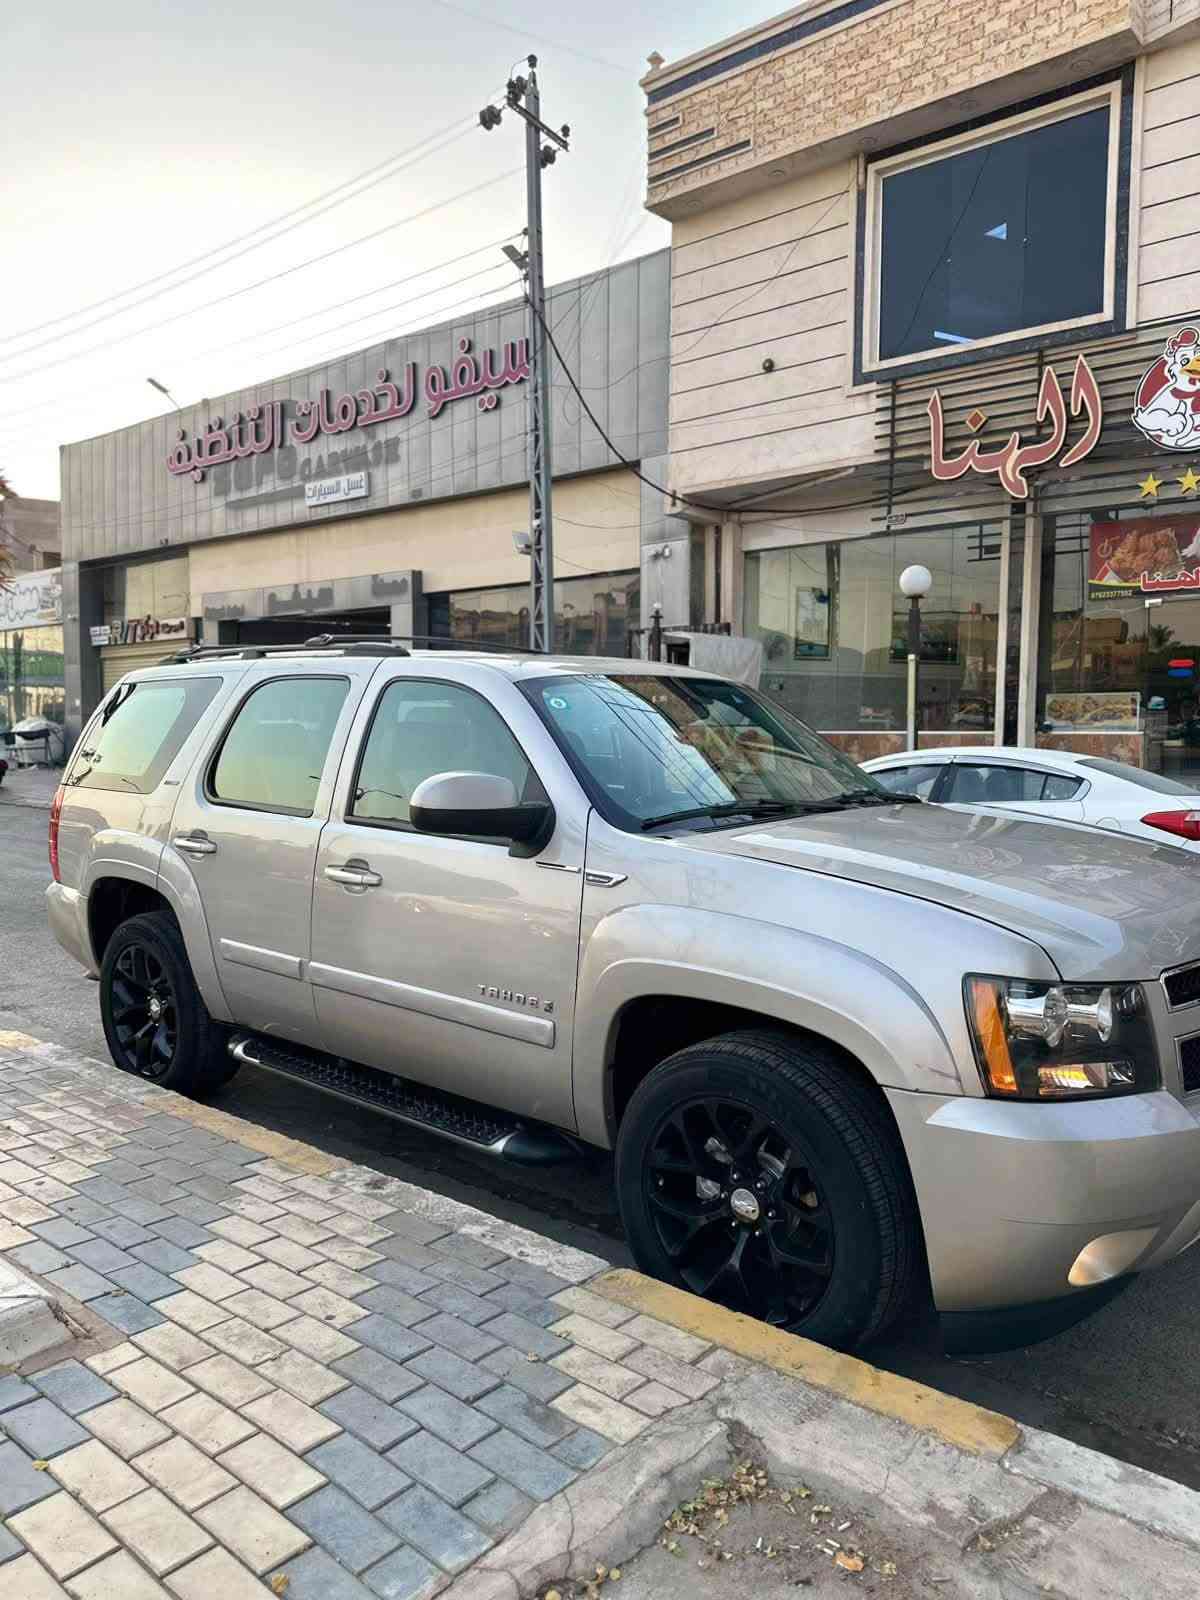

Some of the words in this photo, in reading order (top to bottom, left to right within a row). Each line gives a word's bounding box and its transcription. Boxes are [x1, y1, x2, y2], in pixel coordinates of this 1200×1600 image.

[165, 400, 281, 482] التنظيف
[289, 361, 415, 442] لخدمات
[927, 353, 1102, 498] الهنا
[343, 474, 364, 496] غسل
